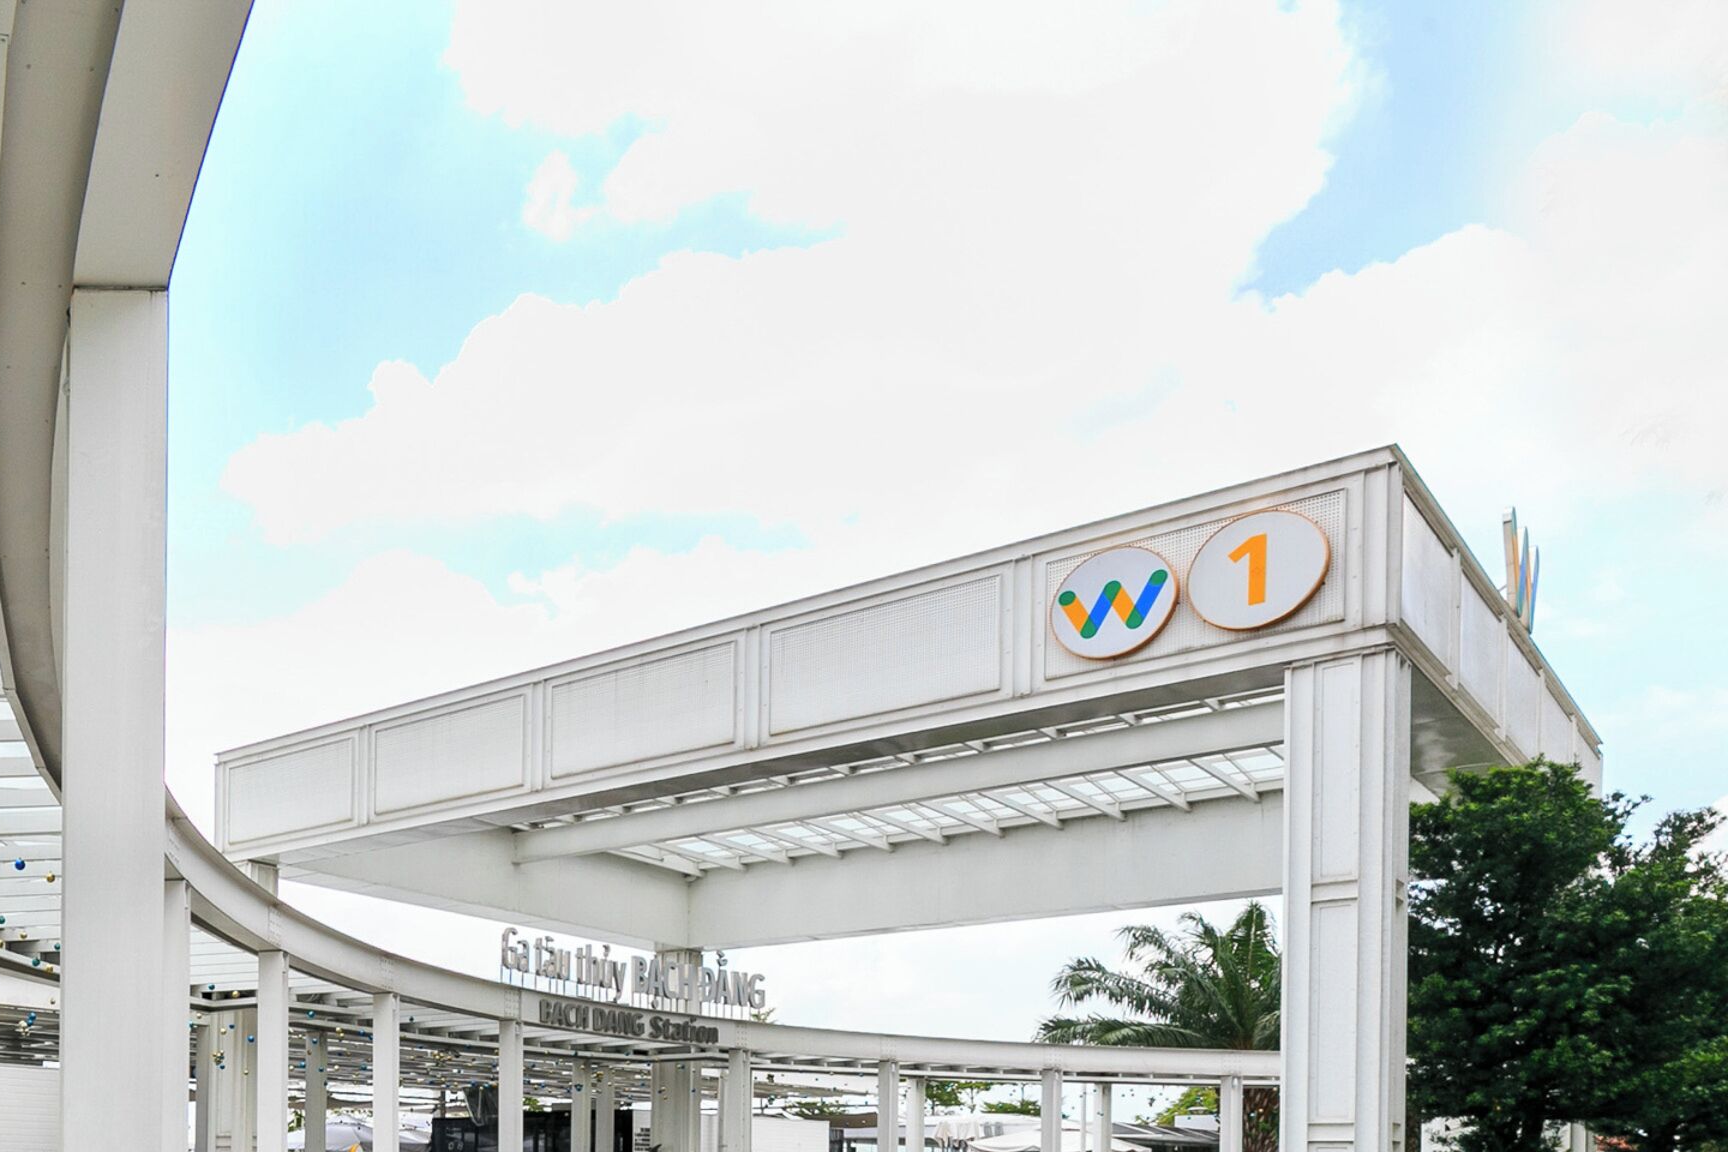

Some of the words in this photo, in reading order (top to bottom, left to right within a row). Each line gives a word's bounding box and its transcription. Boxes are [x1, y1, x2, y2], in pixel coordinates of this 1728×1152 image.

[1228, 533, 1267, 606] 1
[501, 927, 530, 973] Ga
[631, 955, 694, 1009] BẠCH
[539, 999, 590, 1030] BACH
[592, 1007, 645, 1037] DANG
[648, 1015, 719, 1045] Station
